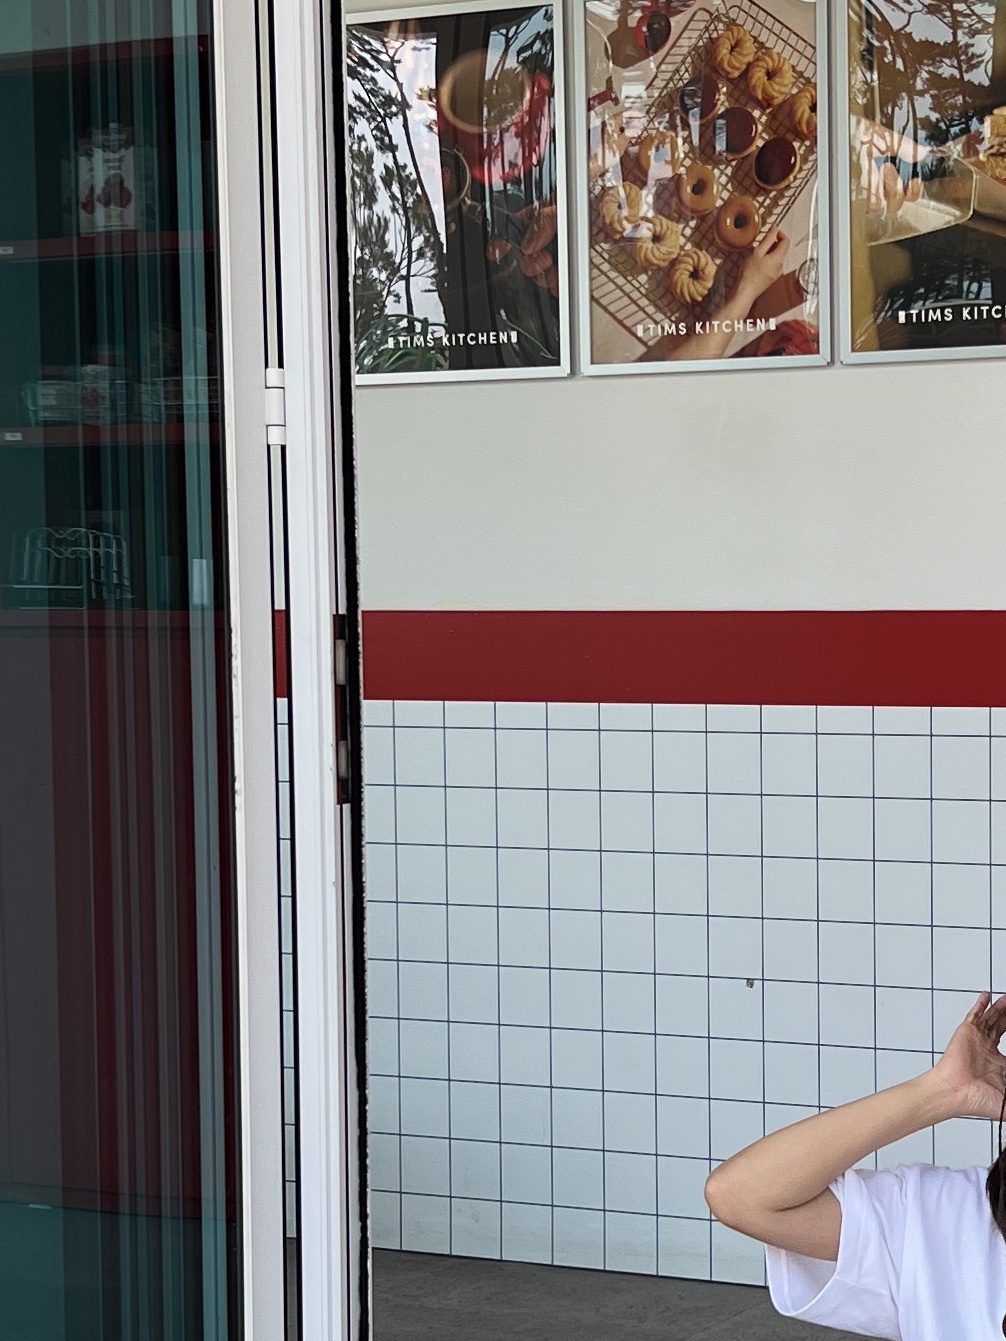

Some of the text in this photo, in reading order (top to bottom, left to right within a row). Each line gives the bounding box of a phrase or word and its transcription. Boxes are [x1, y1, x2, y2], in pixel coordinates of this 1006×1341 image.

[910, 308, 953, 323] TIMS
[648, 317, 765, 336] TIMS KITCHEN
[397, 331, 508, 348] TIMS KITCHEN
